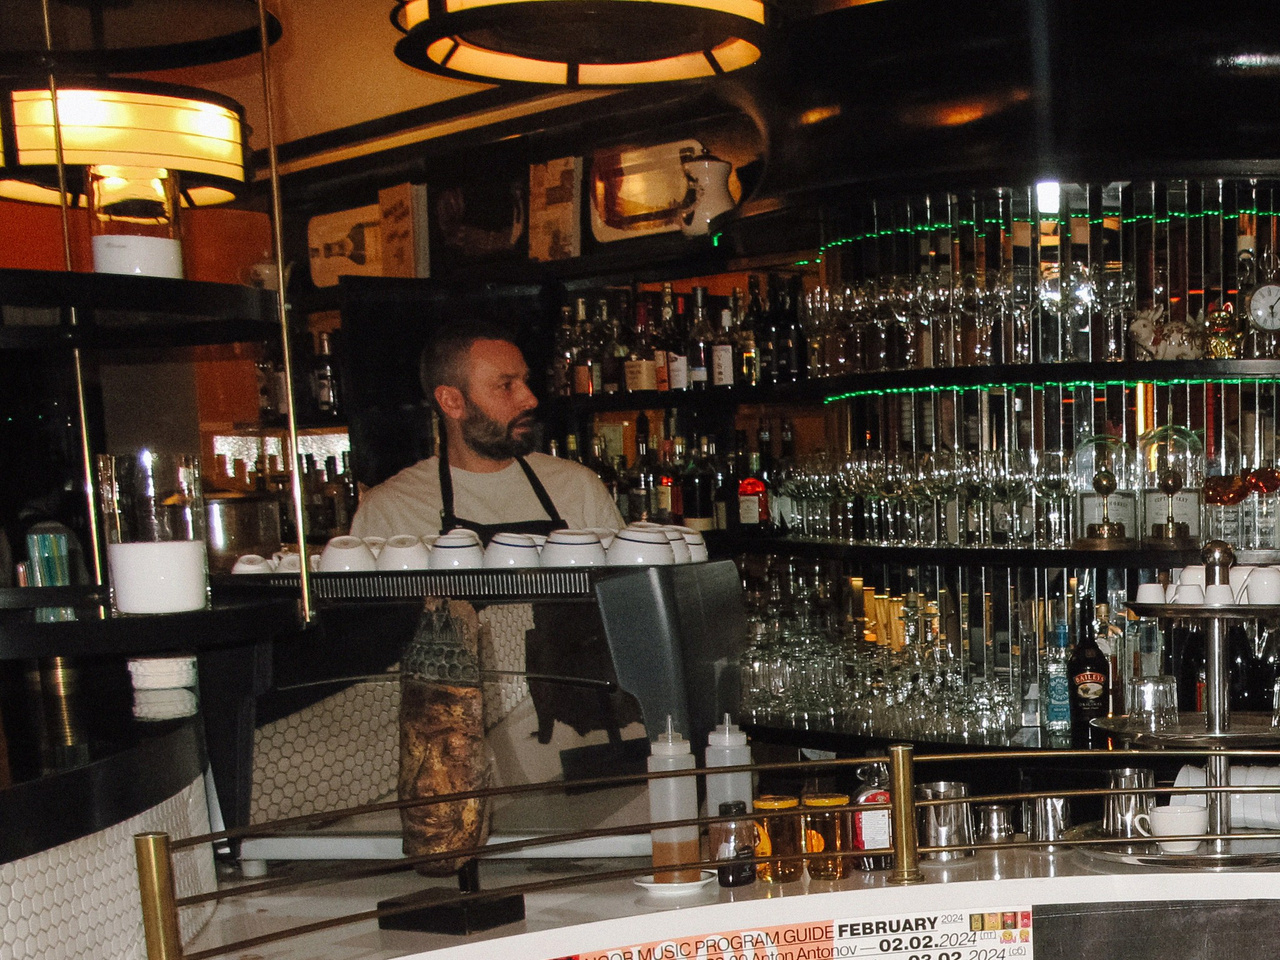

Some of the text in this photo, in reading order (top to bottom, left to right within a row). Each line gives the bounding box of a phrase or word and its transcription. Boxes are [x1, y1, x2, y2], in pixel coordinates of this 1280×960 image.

[695, 931, 780, 955] PROGRAM
[784, 925, 834, 943] GUIDE
[838, 916, 938, 938] FEBRUARY
[797, 945, 857, 960] Antonov
[879, 931, 977, 952] 02.02.2024
